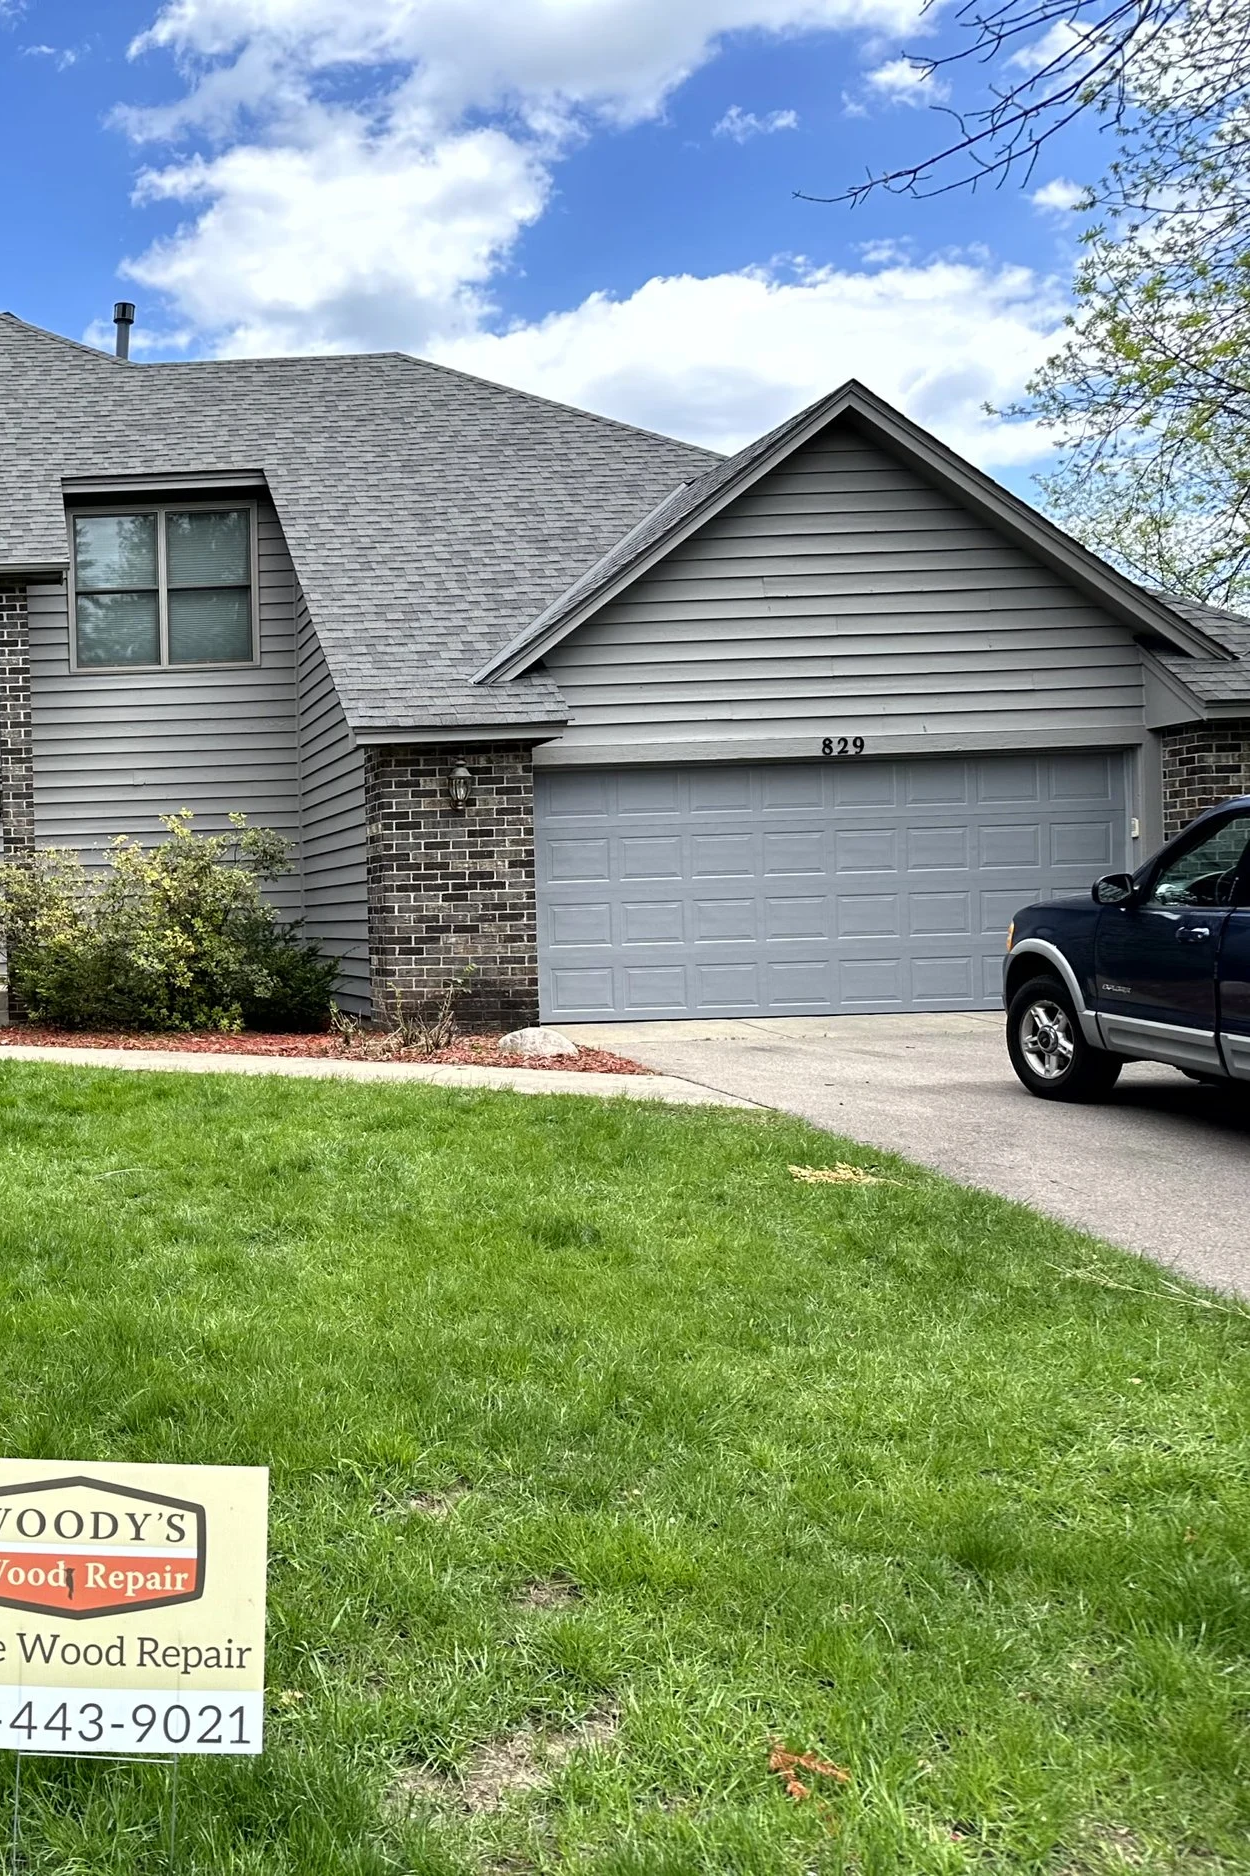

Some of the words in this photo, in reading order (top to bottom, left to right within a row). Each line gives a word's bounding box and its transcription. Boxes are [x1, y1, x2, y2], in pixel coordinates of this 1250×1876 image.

[821, 736, 865, 756] 829
[84, 1561, 189, 1597] Repair
[16, 1632, 126, 1667] Wood
[135, 1636, 253, 1675] Repair
